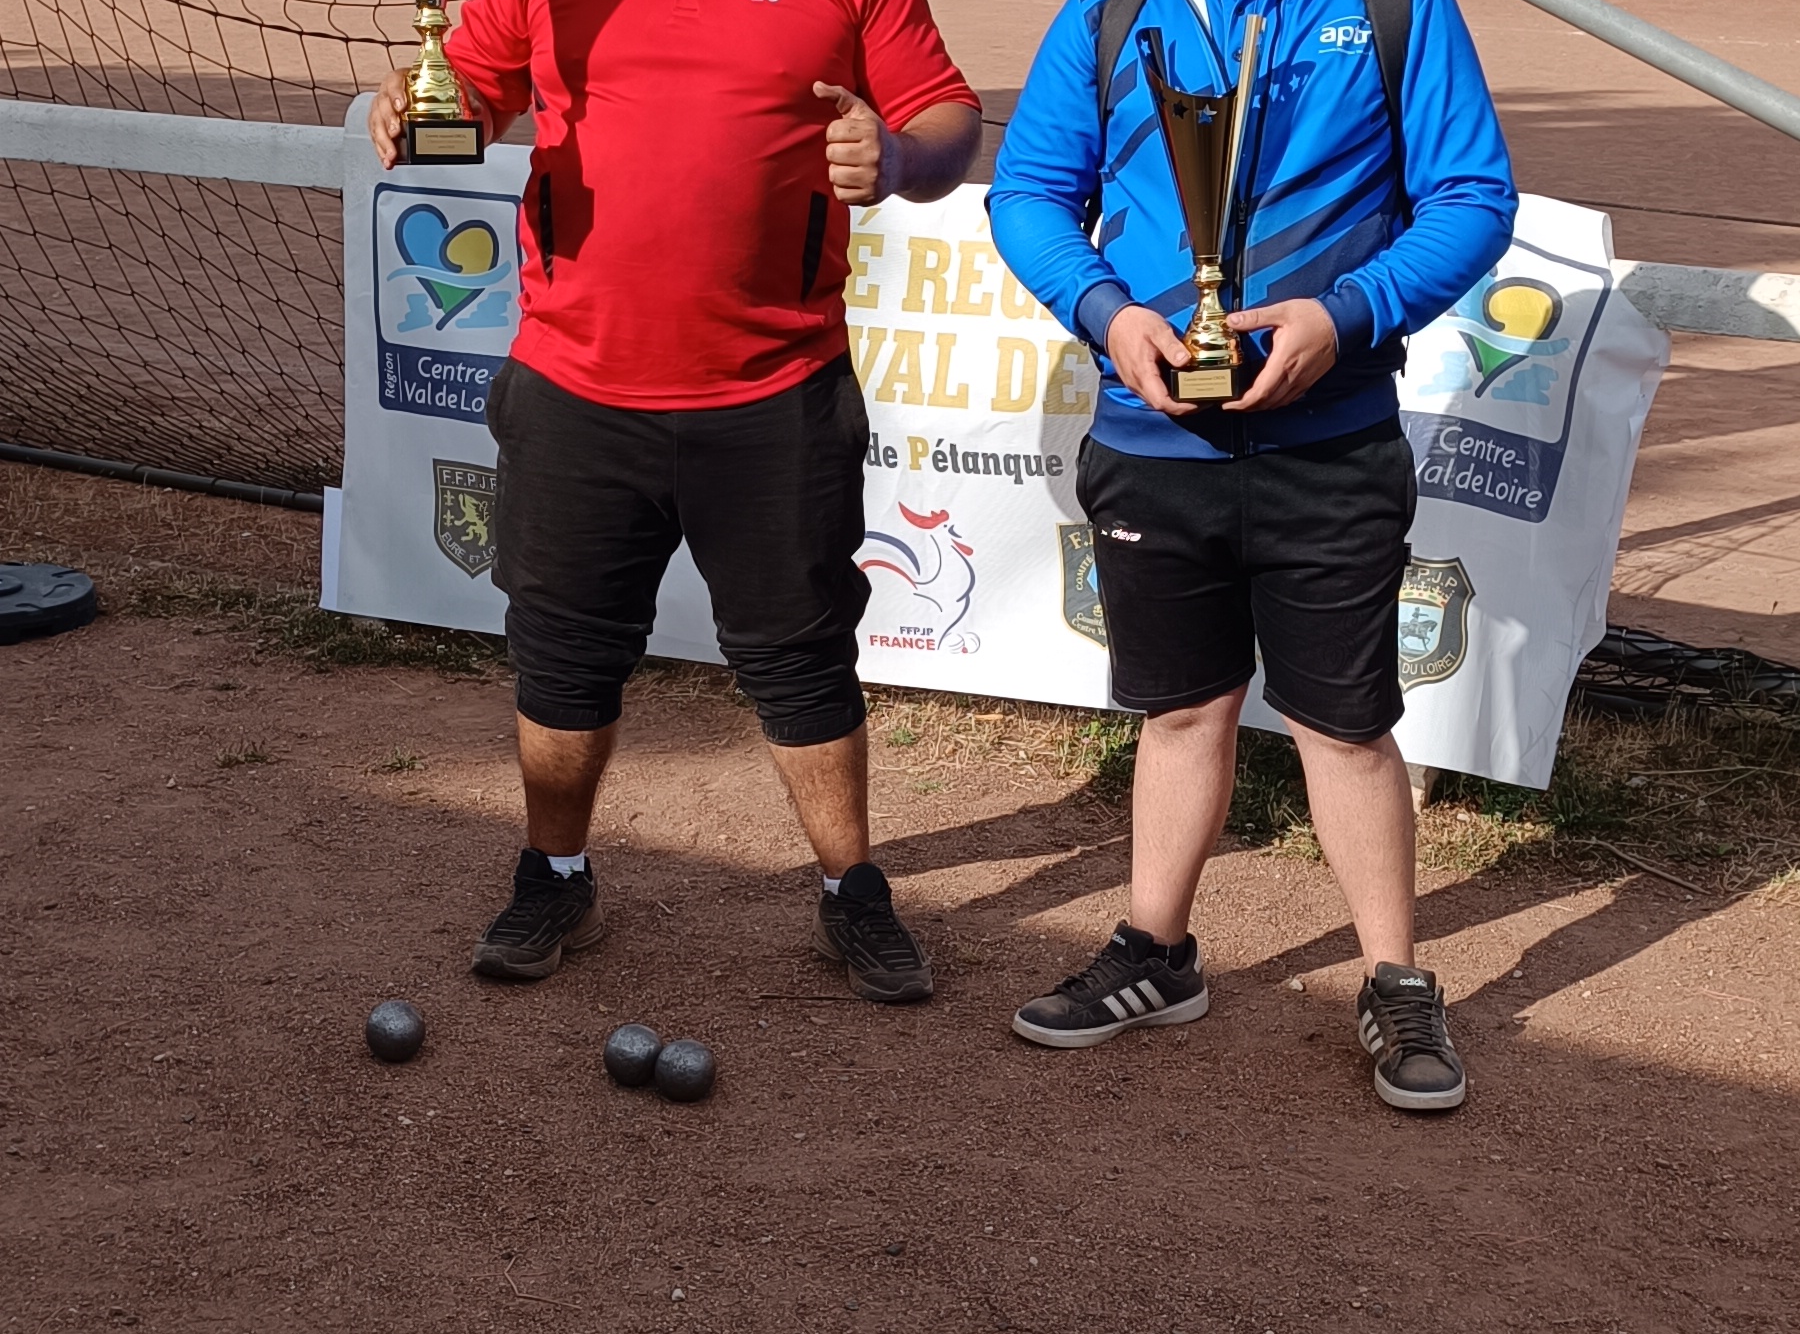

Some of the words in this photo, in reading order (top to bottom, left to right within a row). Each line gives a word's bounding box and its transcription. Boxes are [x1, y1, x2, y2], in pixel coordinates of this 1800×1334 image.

[384, 352, 397, 399] Région
[991, 336, 1093, 415] DE
[906, 435, 1064, 485] Pétanque
[1439, 426, 1526, 468] Centre-
[1484, 470, 1543, 509] Loire
[869, 635, 936, 651] FRANCE
[899, 626, 934, 636] FFPJP
[1402, 662, 1418, 675] DU
[1420, 650, 1457, 675] LOIRET
